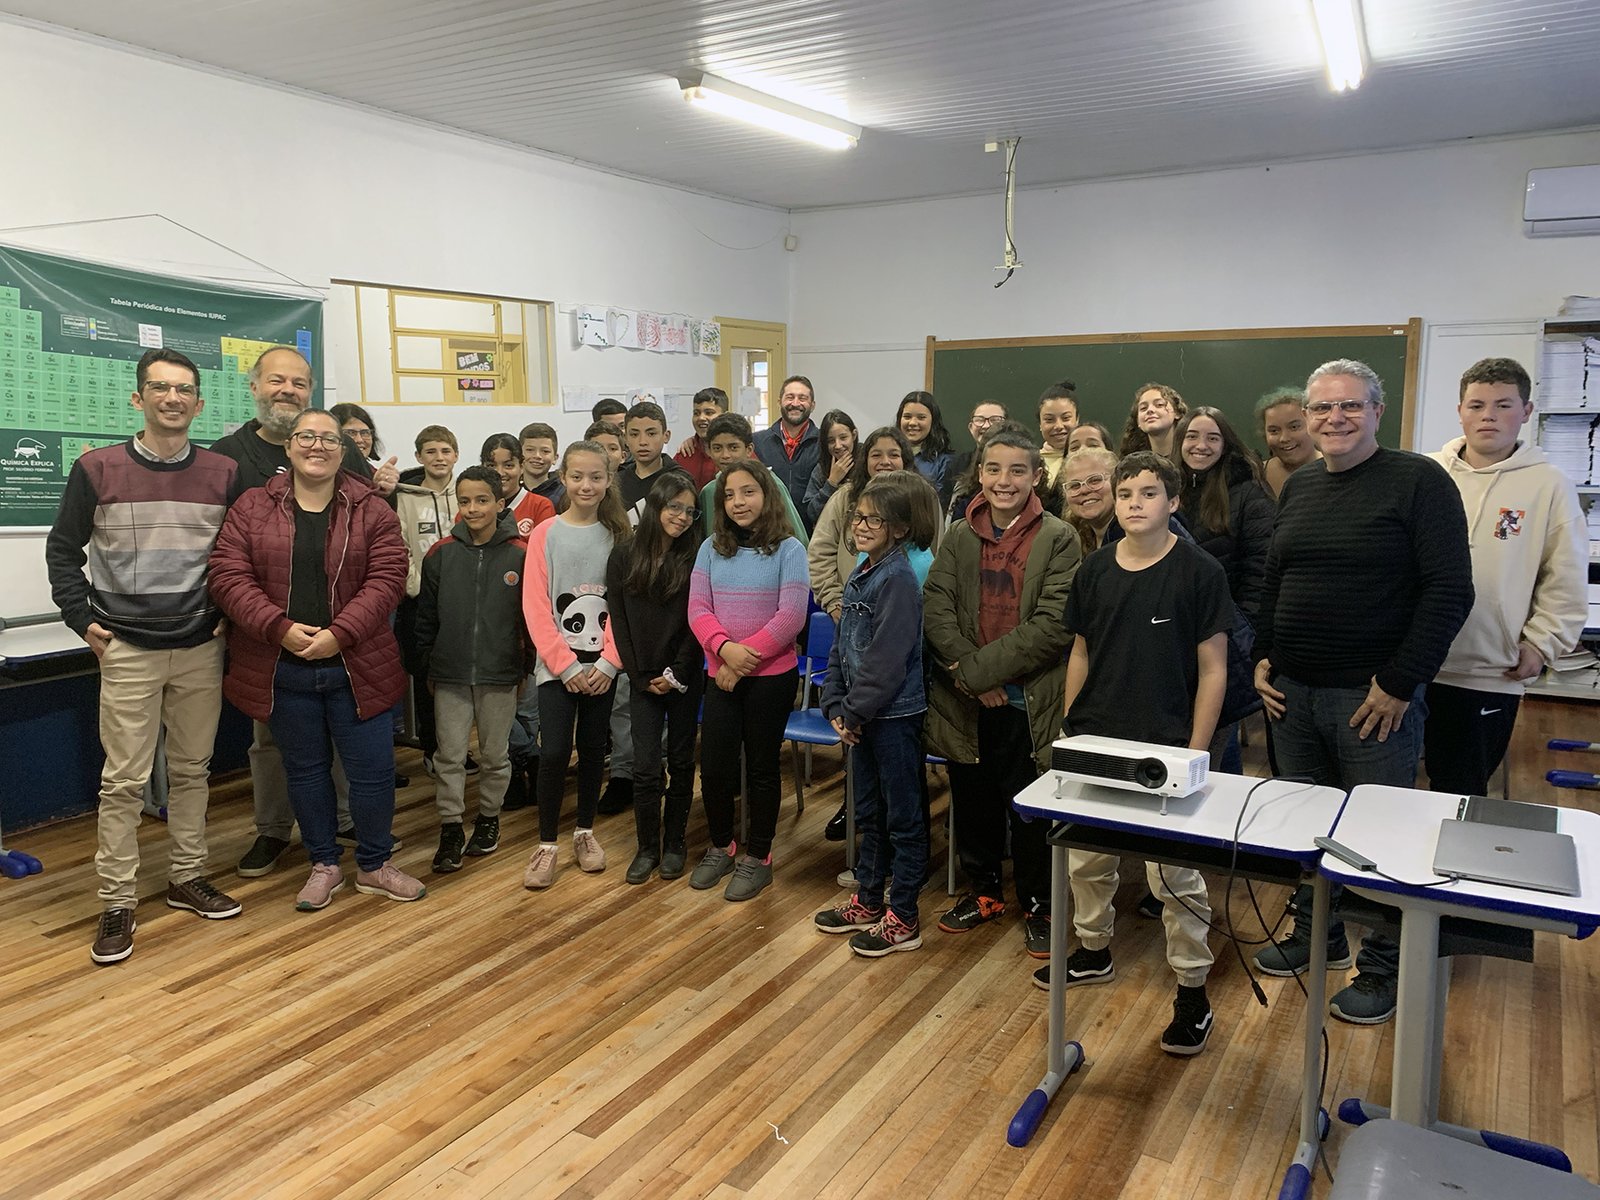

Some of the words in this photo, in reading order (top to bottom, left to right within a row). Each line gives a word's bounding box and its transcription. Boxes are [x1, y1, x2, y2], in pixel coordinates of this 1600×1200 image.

[109, 297, 132, 307] Tabela
[132, 301, 163, 312] Periódica
[163, 305, 176, 313] dos
[176, 307, 208, 318] Elementos
